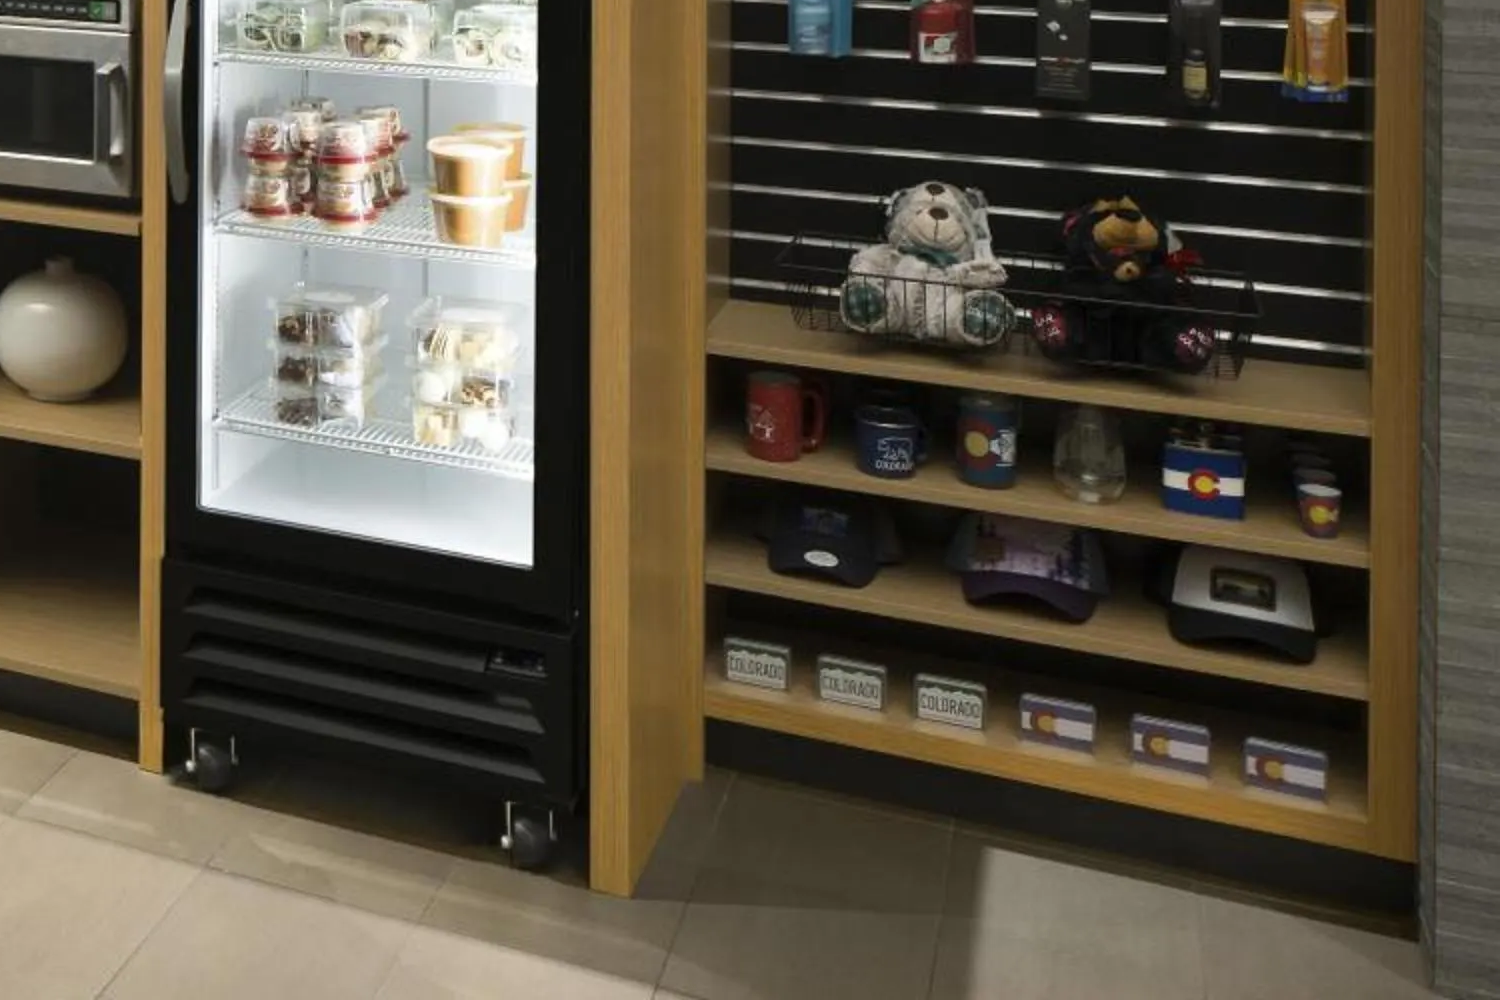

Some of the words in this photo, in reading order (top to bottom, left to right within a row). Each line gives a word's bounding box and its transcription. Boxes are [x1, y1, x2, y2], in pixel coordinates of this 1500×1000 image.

[729, 655, 784, 681] COLORADO
[821, 674, 880, 700] COLORADO
[920, 692, 981, 718] COLORADO
